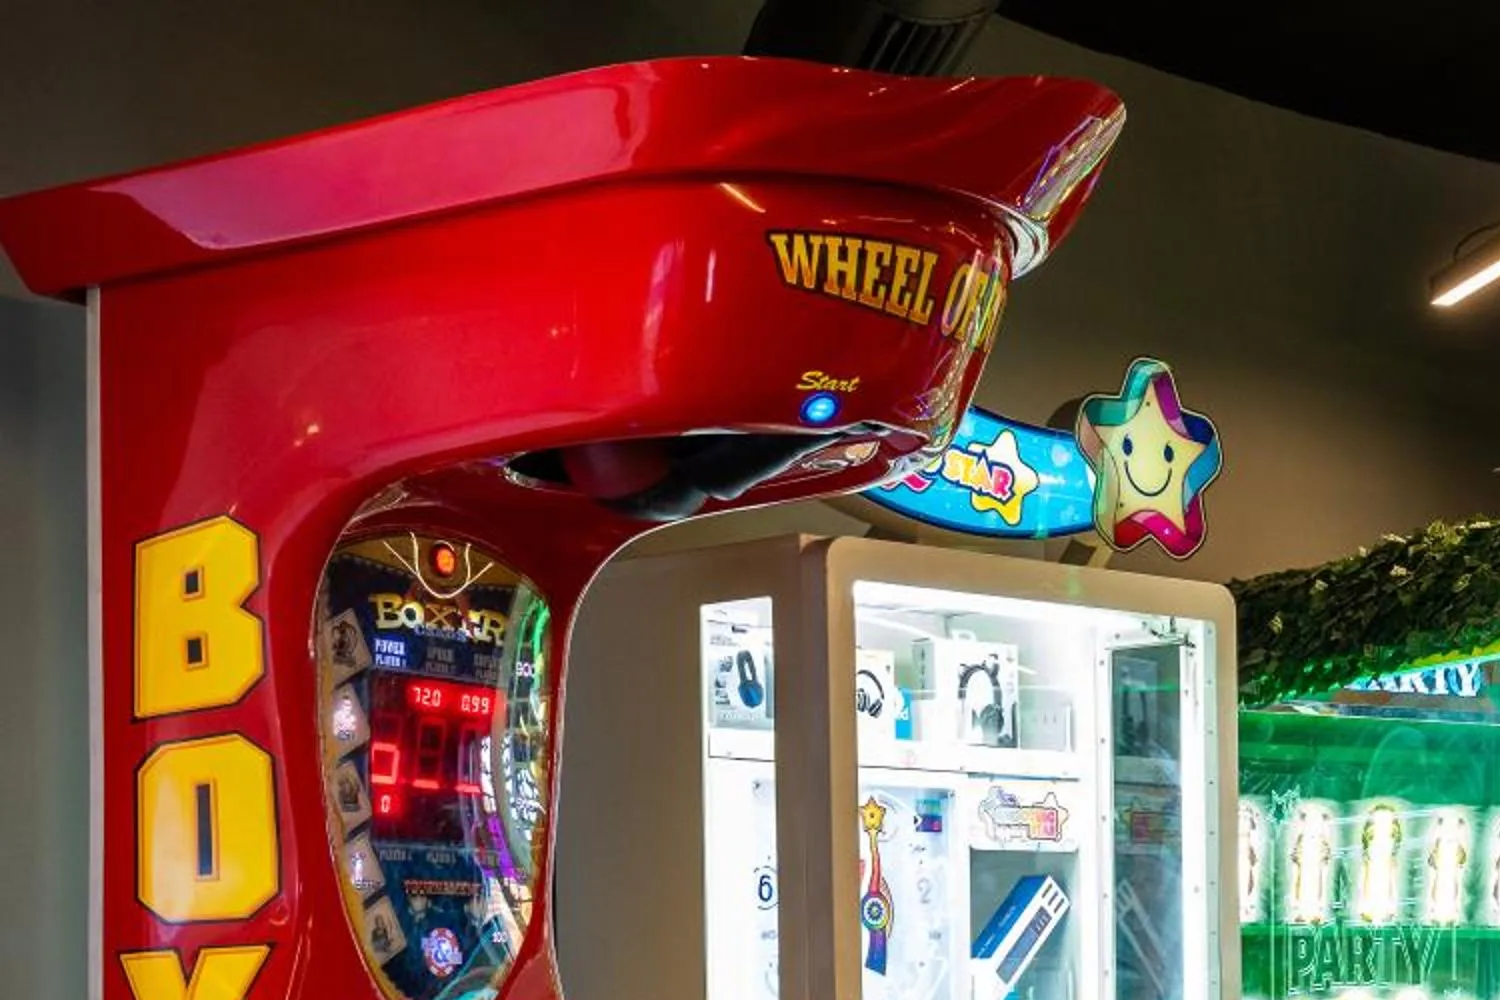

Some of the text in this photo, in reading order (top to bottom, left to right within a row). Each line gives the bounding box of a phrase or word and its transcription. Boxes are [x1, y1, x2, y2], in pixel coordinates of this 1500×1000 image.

[768, 231, 939, 327] WHEEL
[796, 370, 860, 392] Start
[758, 874, 773, 902] 6
